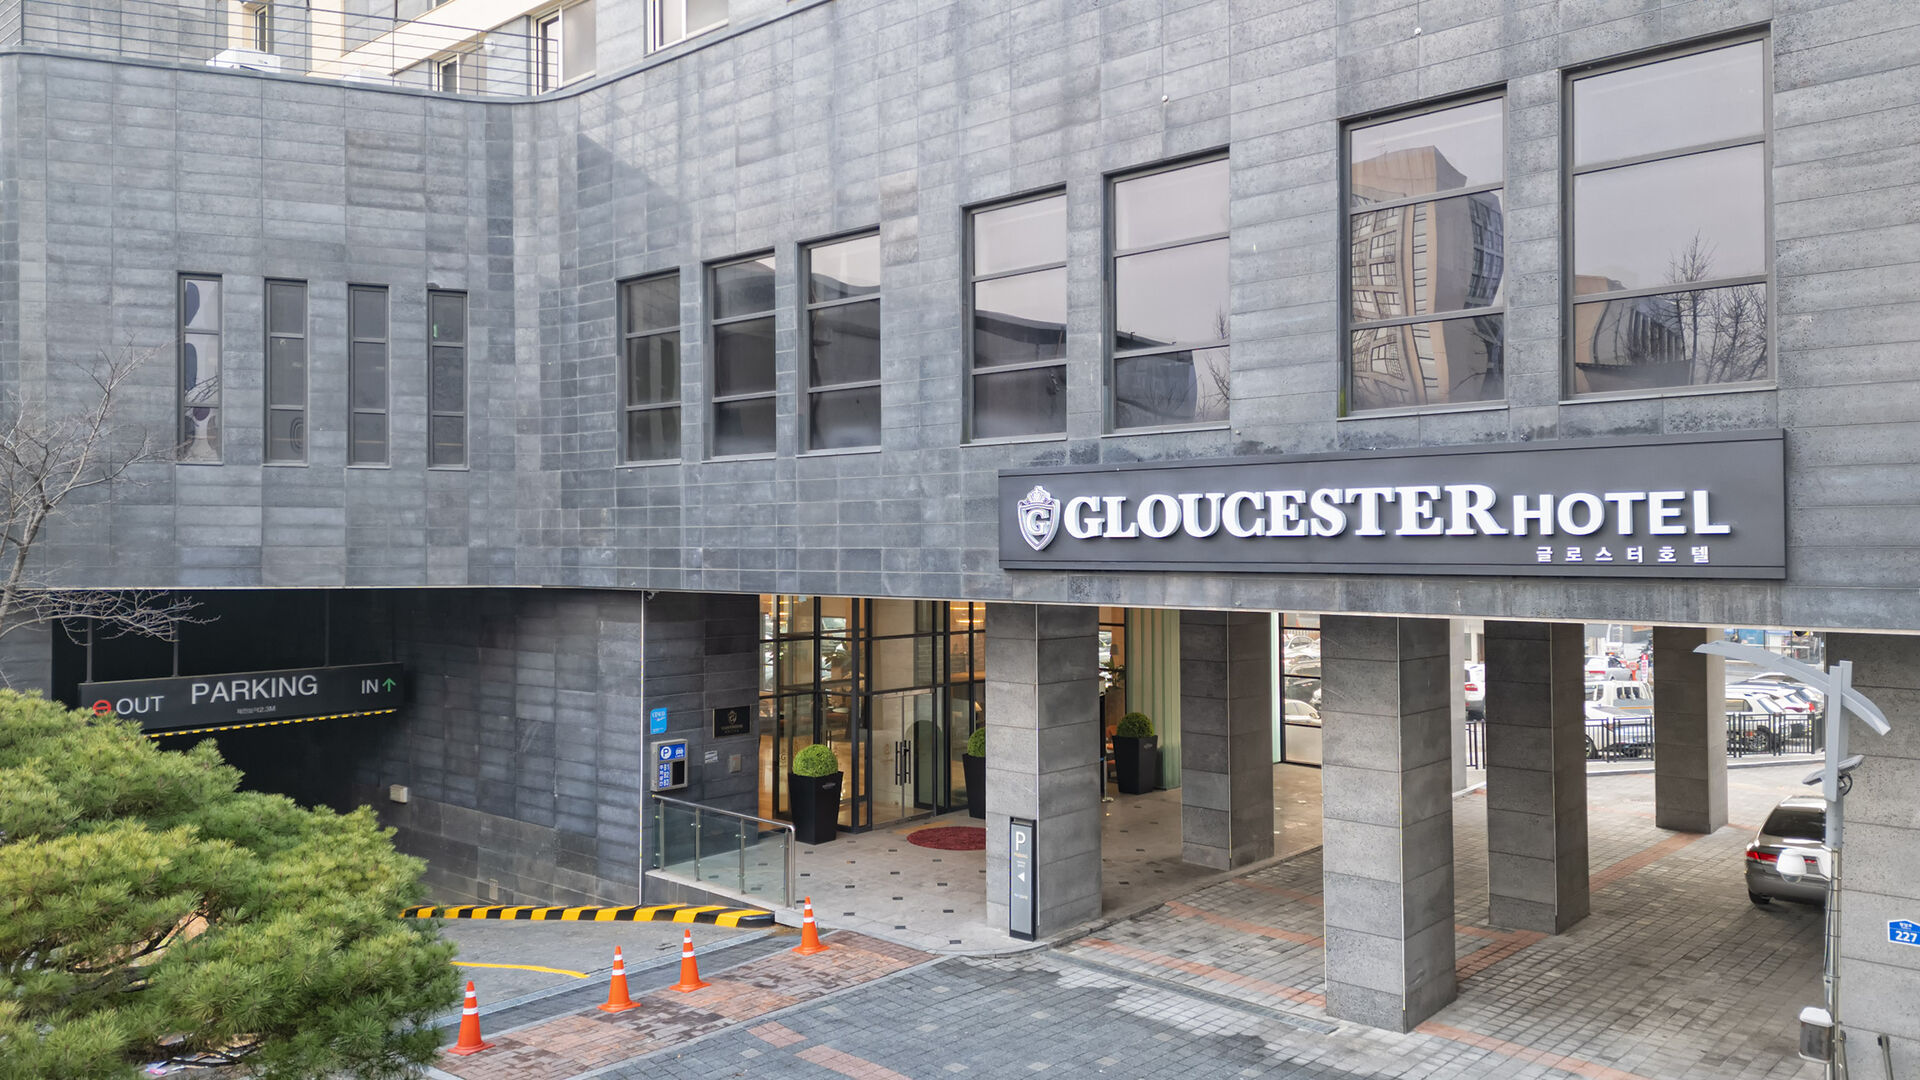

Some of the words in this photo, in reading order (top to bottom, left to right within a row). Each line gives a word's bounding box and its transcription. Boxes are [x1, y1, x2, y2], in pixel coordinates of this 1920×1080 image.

[1063, 484, 1510, 539] GLOUCESTER
[1512, 490, 1732, 536] HOTEL
[1536, 546, 1710, 563] 글로스터호텔
[191, 675, 318, 704] PARKING
[361, 679, 379, 694] IN
[115, 695, 165, 715] OUT
[1015, 831, 1026, 851] P
[1896, 931, 1917, 943] 227
